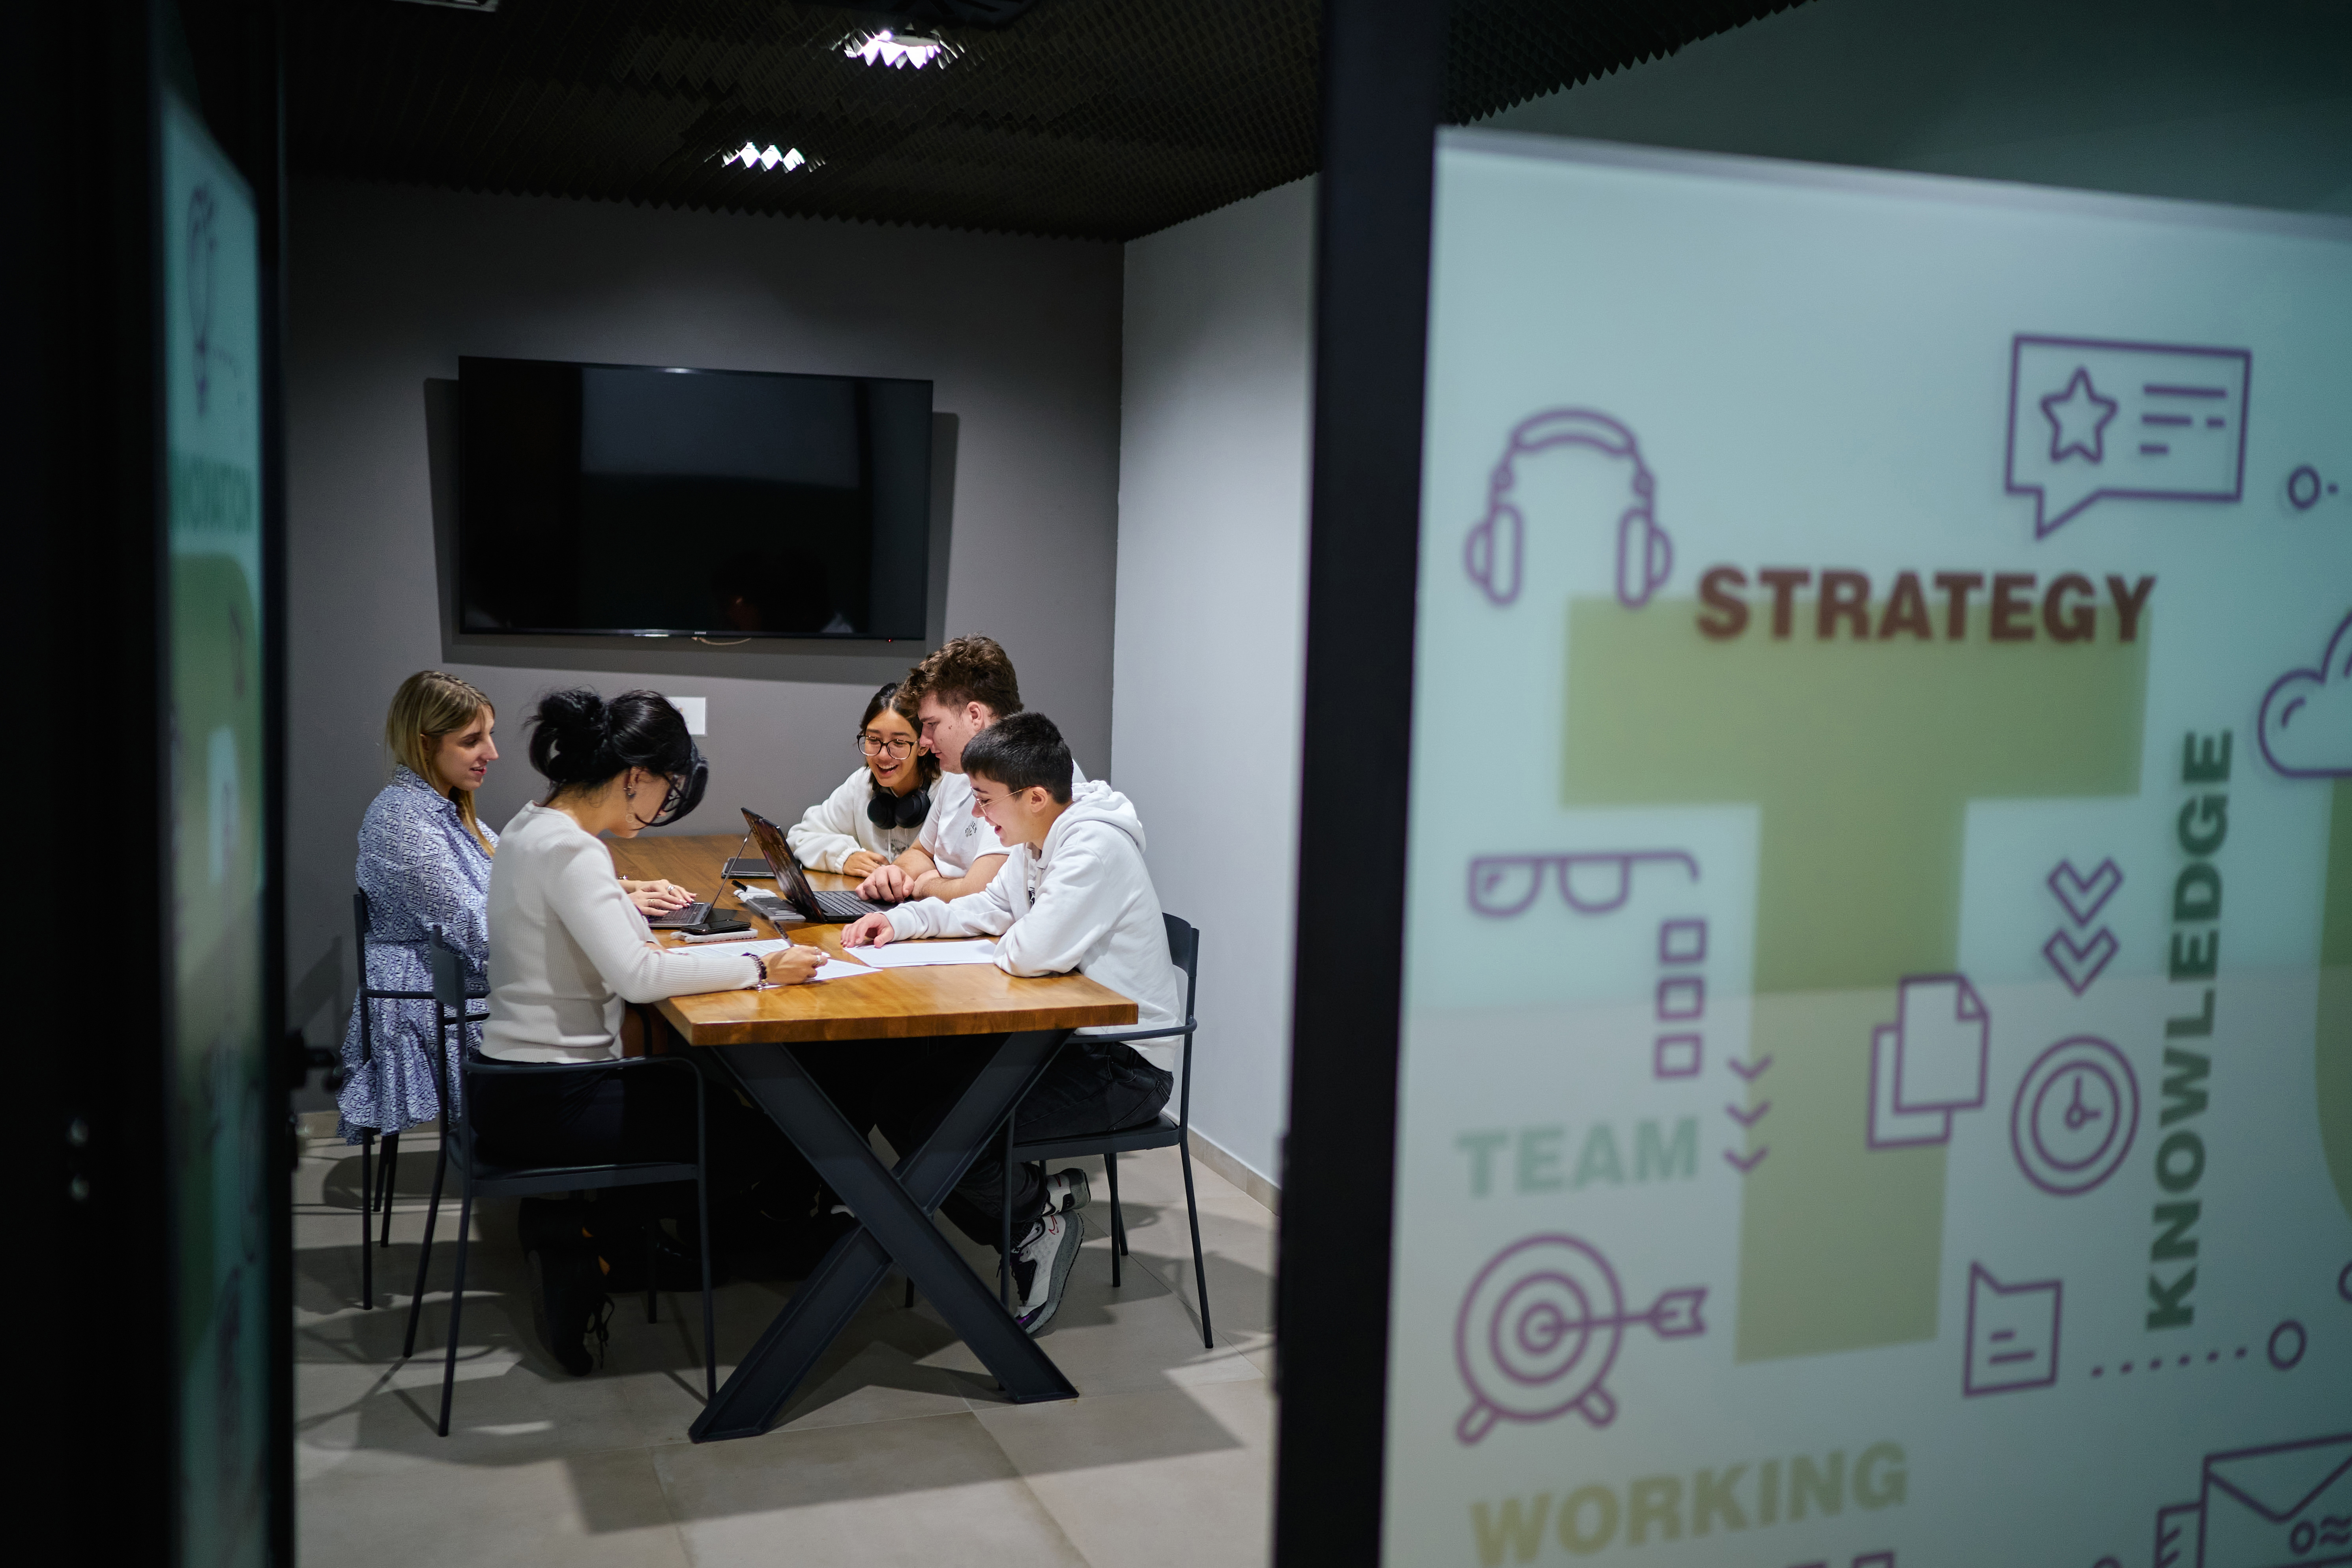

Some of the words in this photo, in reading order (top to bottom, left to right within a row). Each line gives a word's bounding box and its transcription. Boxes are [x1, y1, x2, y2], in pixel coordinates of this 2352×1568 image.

[1696, 565, 2157, 642] STRATEGY
[2146, 729, 2232, 1331] KNOWLEDGE
[1455, 1116, 1699, 1197] TEAM
[1470, 1442, 1907, 1568] WORKING
